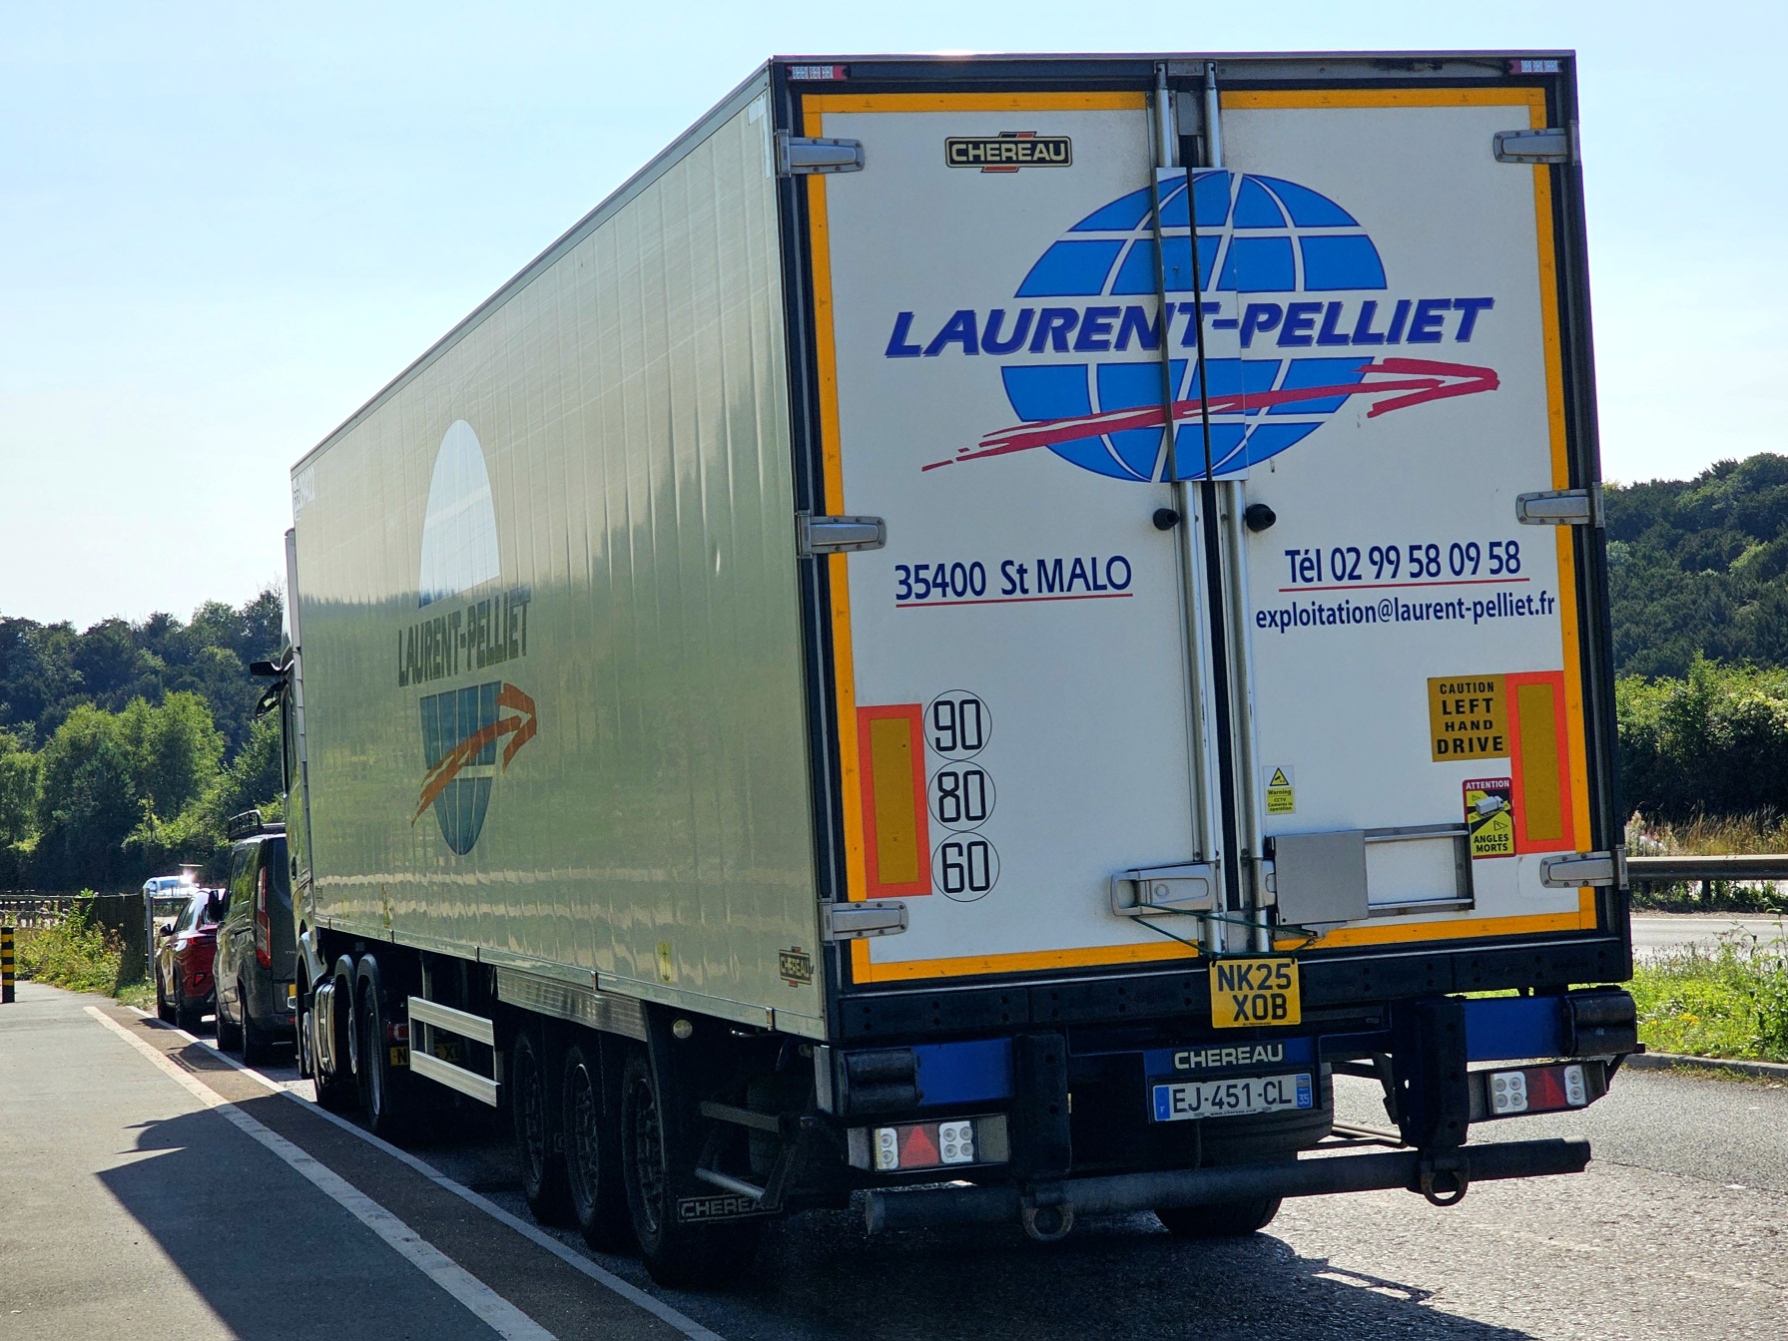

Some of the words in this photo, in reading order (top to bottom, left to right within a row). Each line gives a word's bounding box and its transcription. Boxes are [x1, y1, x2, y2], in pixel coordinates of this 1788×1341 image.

[951, 142, 1066, 162] CHEREAU
[885, 296, 1494, 358] LAURENT-PELLIET
[1285, 547, 1322, 583] Tél
[1331, 546, 1362, 581] 02
[1369, 545, 1401, 580] 99
[1408, 543, 1441, 579] 58
[1449, 541, 1481, 577] 09
[1489, 540, 1521, 575] 58
[894, 561, 986, 601] 35400
[1000, 559, 1029, 596] St
[1036, 555, 1132, 593] MALO
[1256, 590, 1555, 633] exploitation@laurent-pelliet.fr
[398, 584, 531, 688] LAURENT-PELLIET
[1439, 681, 1495, 695] CAUTION
[1441, 698, 1494, 715] LEFT
[933, 699, 983, 752] 90
[1444, 719, 1494, 732] HAND
[1437, 736, 1504, 755] DRIVE
[937, 769, 987, 823] 80
[1466, 779, 1510, 790] ATTENTION
[1474, 833, 1509, 844] ANGLES
[1476, 843, 1508, 853] MORTS
[941, 840, 990, 894] 60
[1217, 963, 1292, 992] NK25
[1232, 993, 1288, 1021] XOB
[1174, 1044, 1283, 1070] CHEREAU
[1298, 1093, 1310, 1105] 35
